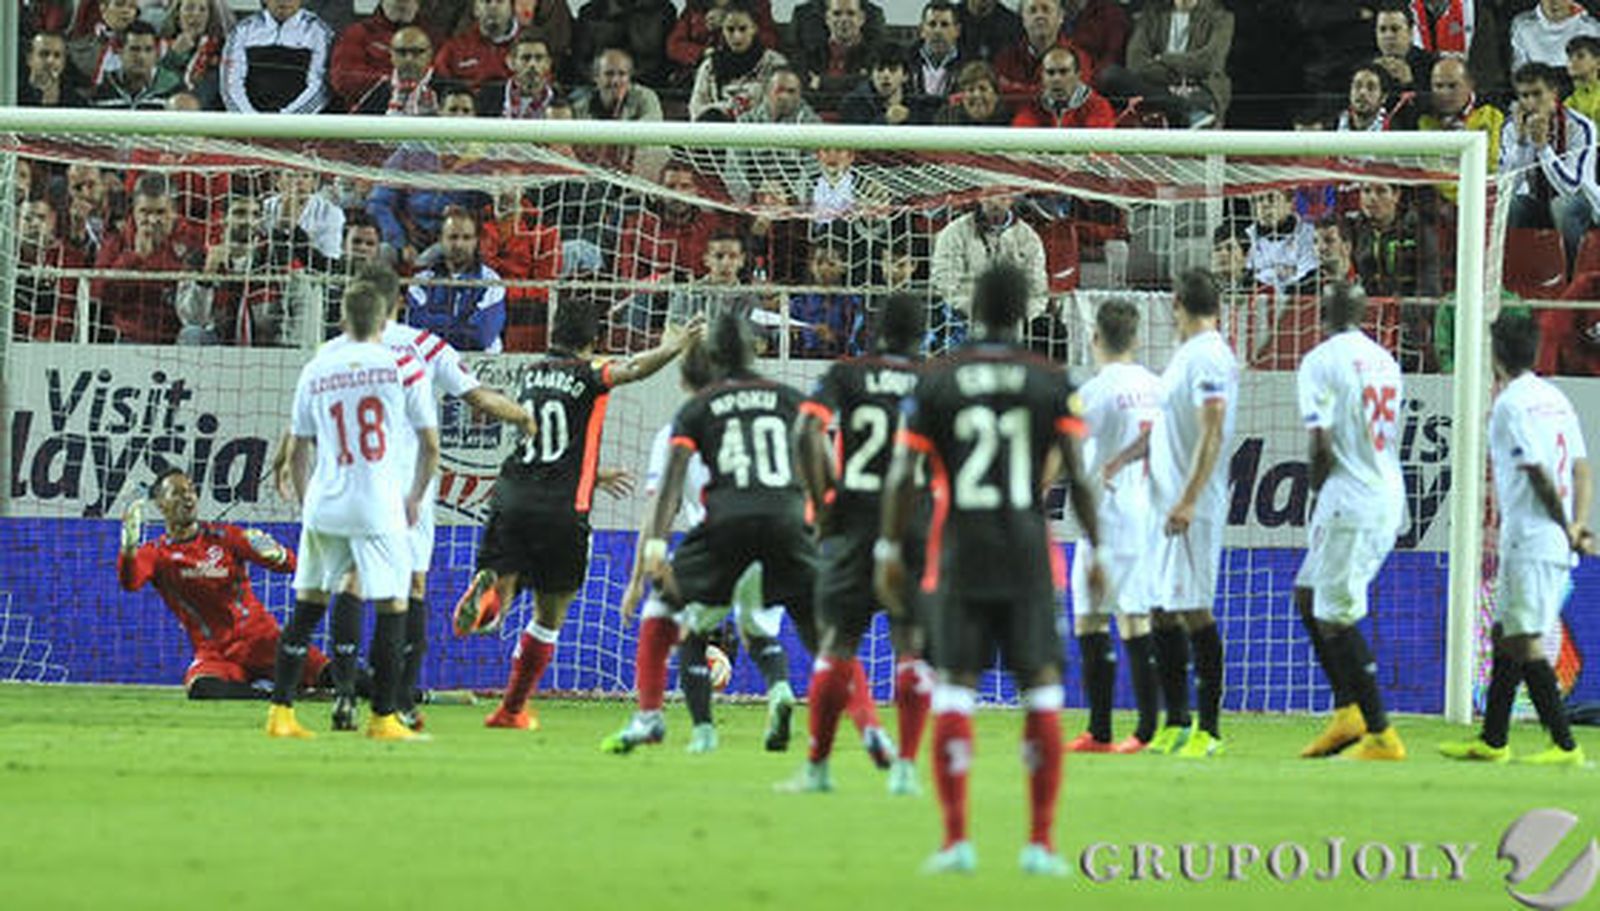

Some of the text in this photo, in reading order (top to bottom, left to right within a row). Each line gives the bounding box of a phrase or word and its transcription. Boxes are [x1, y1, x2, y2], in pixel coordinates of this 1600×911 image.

[47, 368, 192, 433] Visit
[329, 396, 386, 466] 18
[717, 415, 791, 489] 40
[954, 405, 1032, 511] 21
